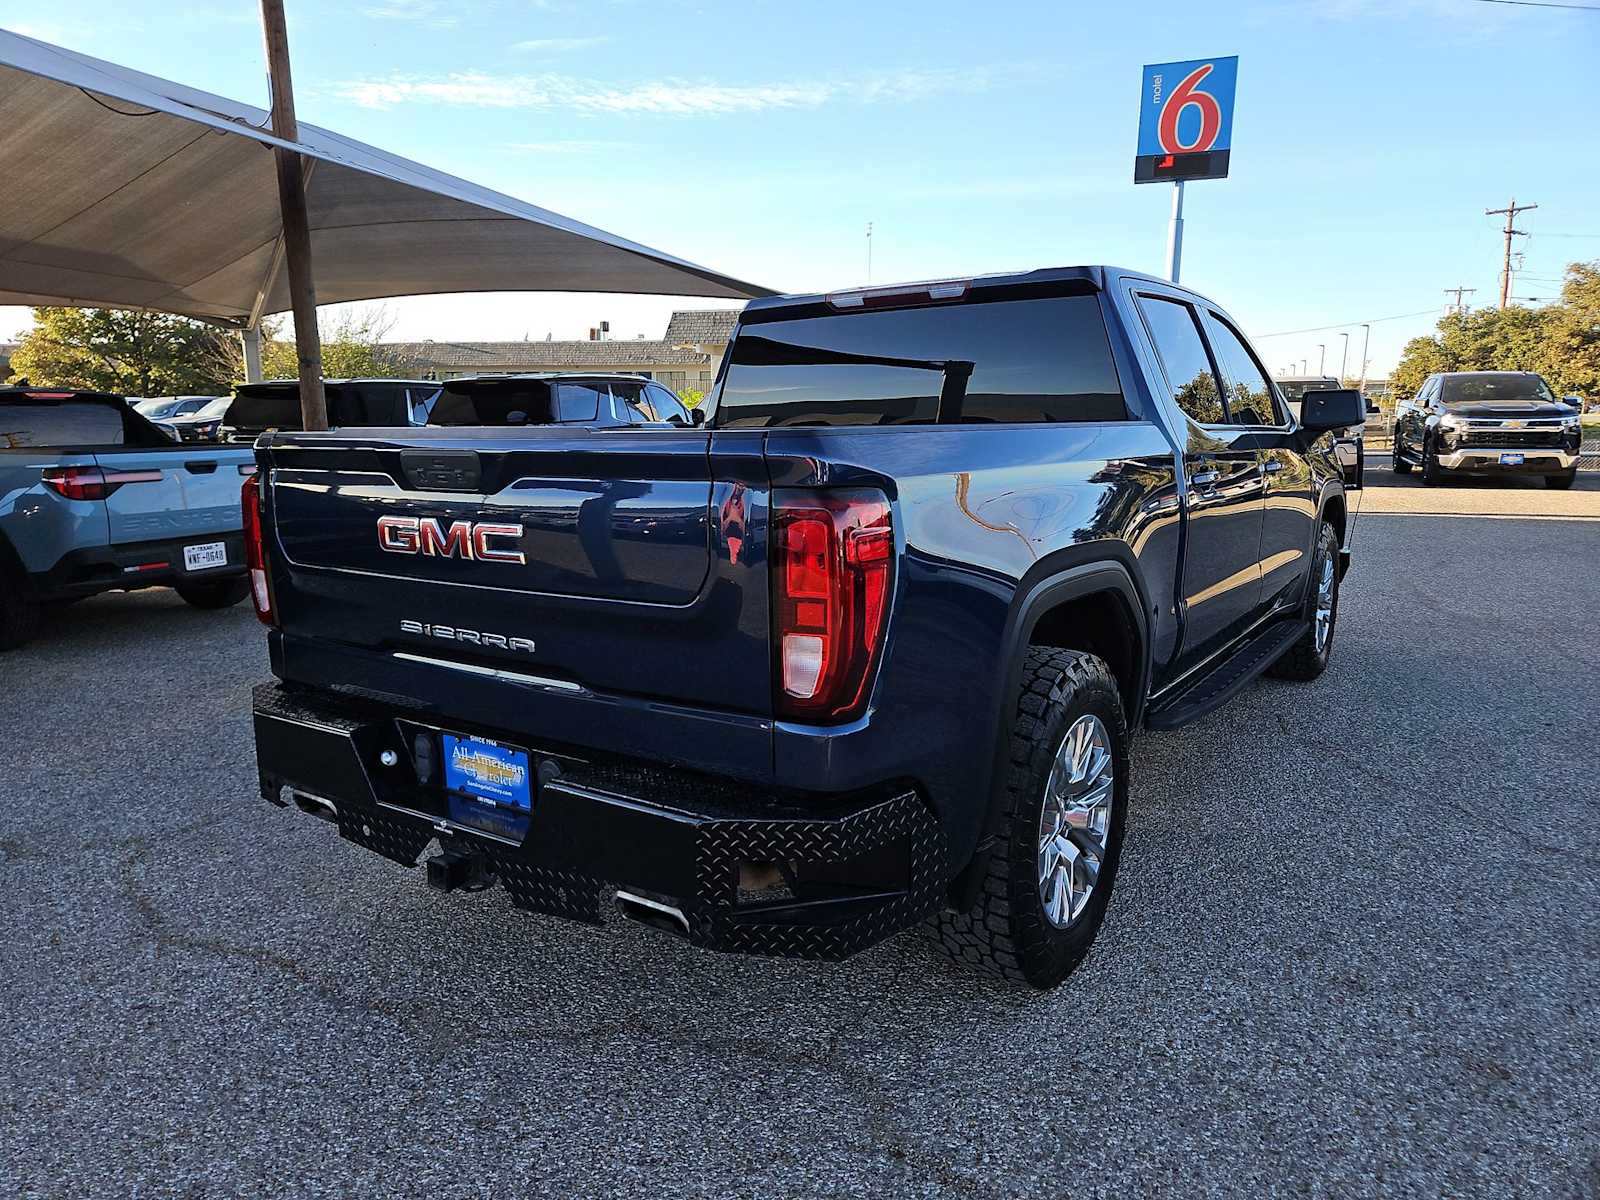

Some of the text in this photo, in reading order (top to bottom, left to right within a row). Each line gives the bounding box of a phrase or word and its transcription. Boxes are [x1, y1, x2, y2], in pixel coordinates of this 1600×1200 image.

[1152, 74, 1162, 104] motel
[1157, 63, 1221, 155] 6
[376, 514, 528, 565] GMC
[400, 619, 536, 653] SIERRA
[452, 745, 525, 776] All American
[463, 761, 514, 787] Chrolet
